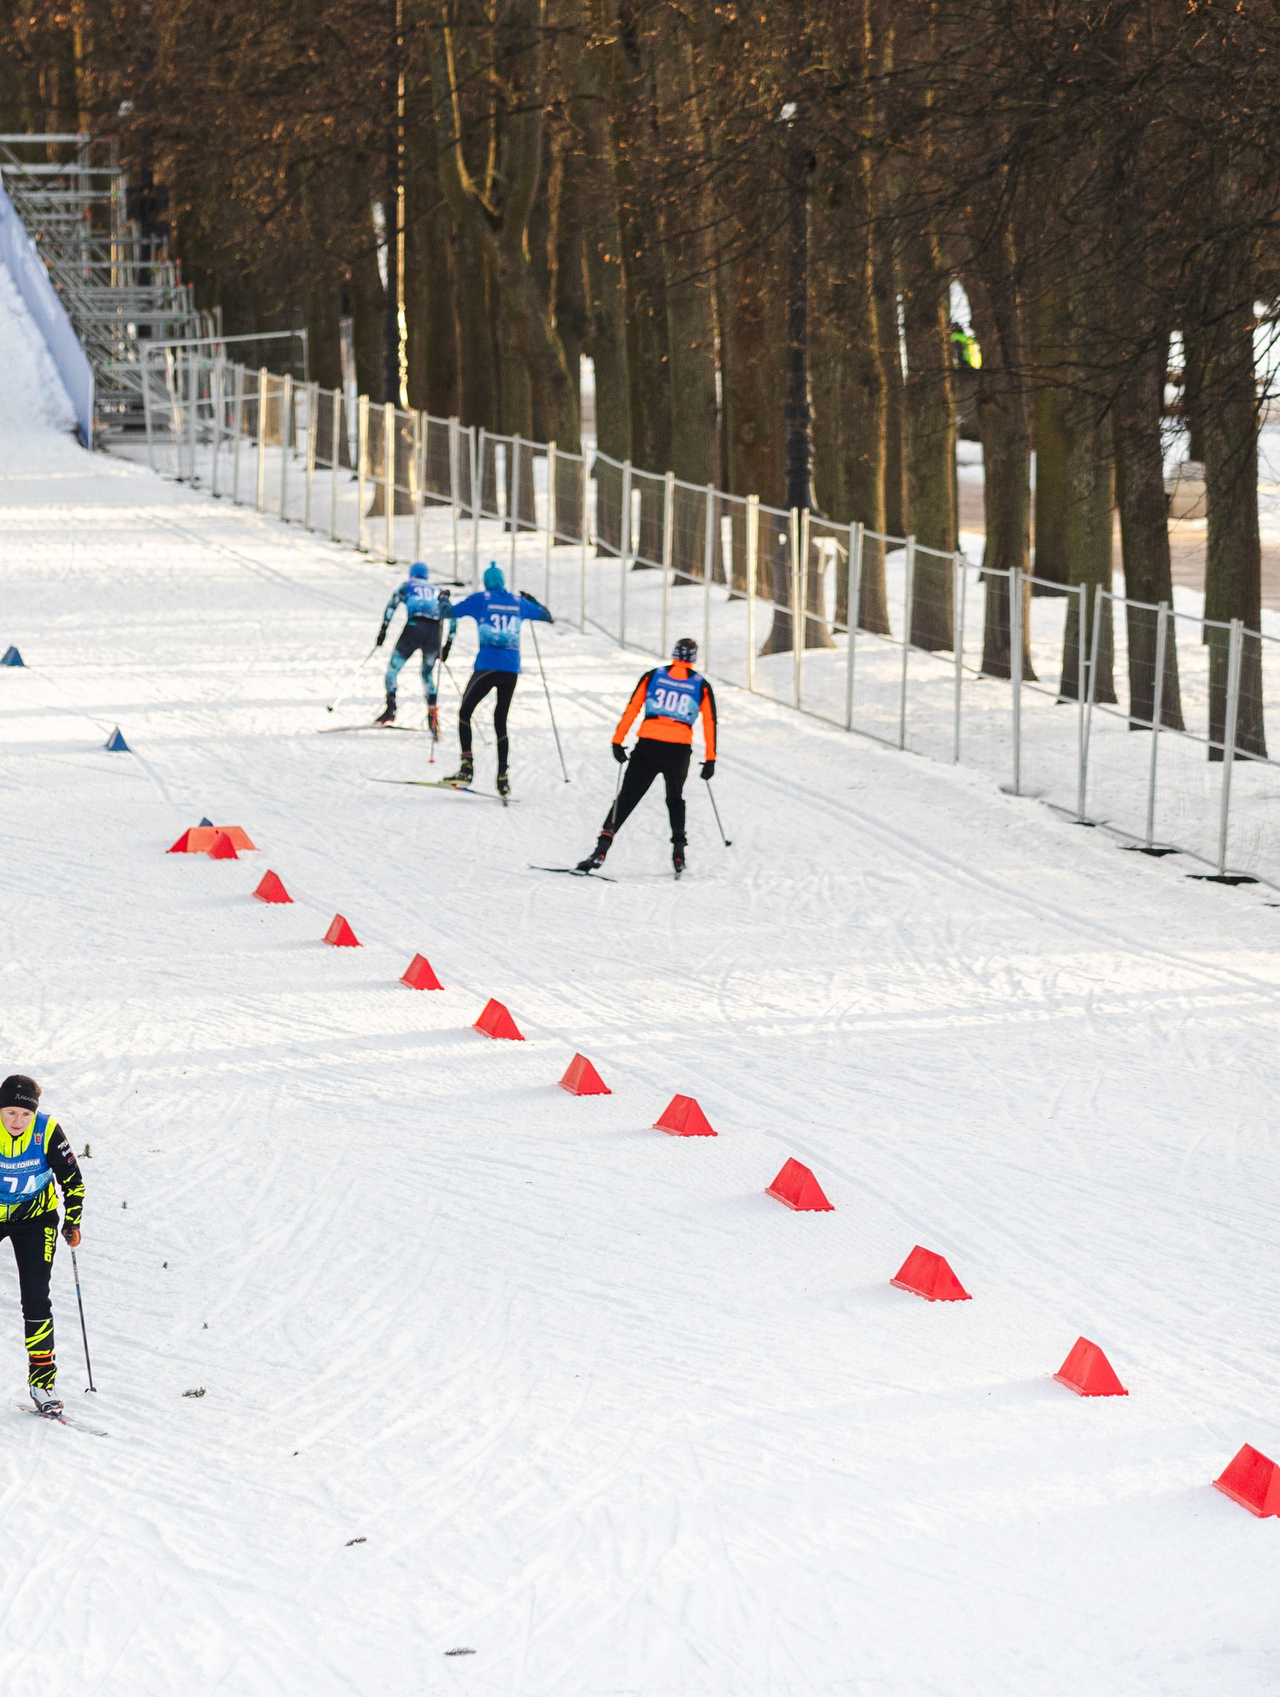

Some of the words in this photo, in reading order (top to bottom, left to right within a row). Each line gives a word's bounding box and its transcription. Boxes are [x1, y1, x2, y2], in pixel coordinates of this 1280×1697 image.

[414, 586, 439, 602] 30
[490, 613, 517, 633] 314
[653, 688, 690, 715] 308
